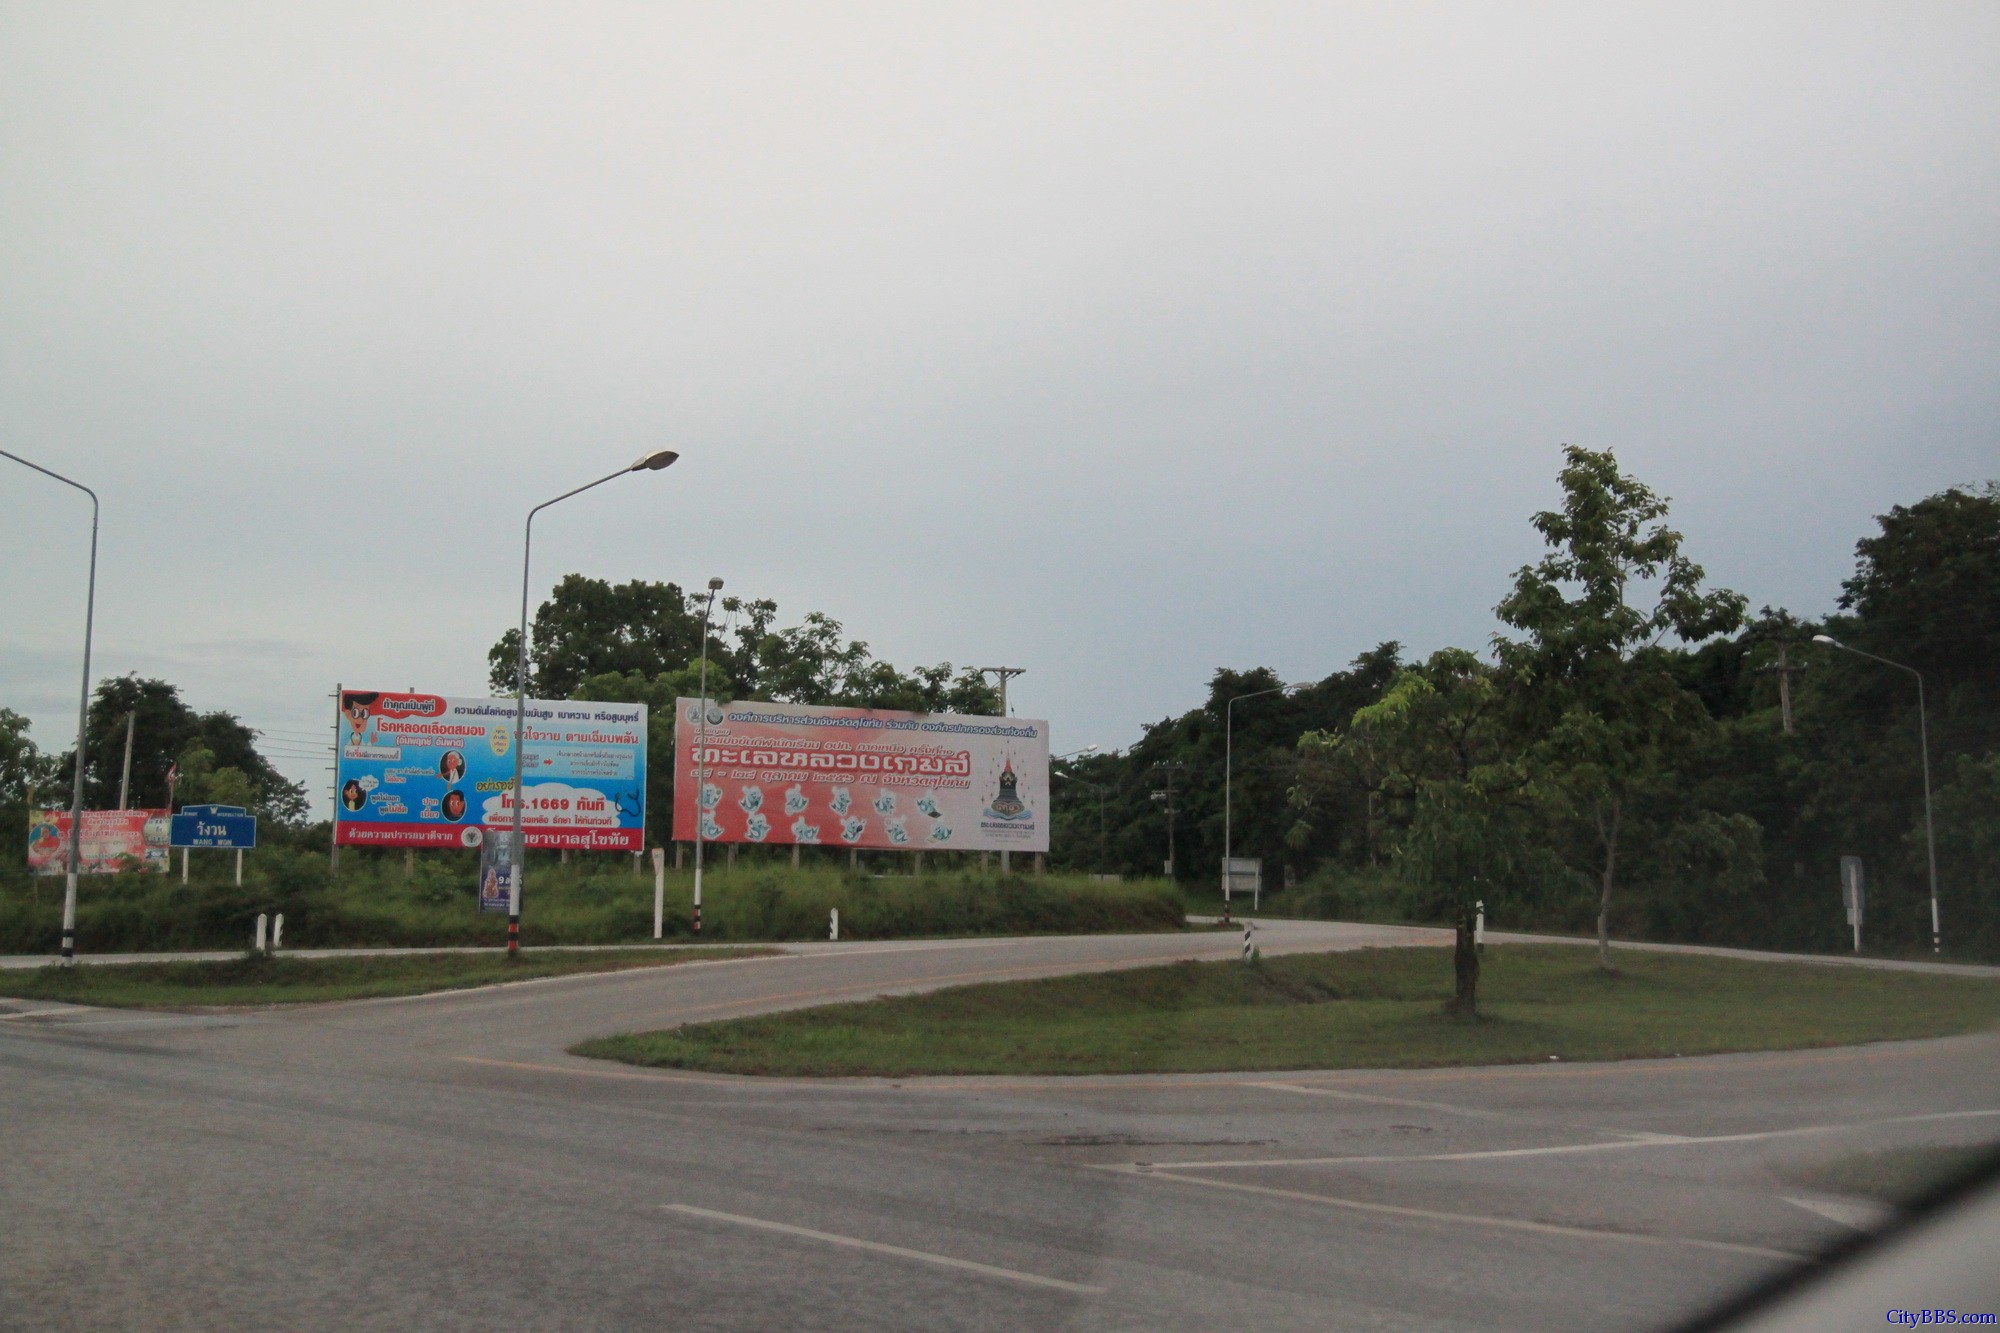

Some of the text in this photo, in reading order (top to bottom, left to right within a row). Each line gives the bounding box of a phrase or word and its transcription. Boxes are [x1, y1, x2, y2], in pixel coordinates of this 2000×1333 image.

[383, 698, 436, 714] ถ้าคุณเป็นผู้ที่
[454, 704, 518, 719] ความดันโลหิตสูง
[557, 711, 591, 721] เบาหวาน
[594, 709, 640, 724] หรือสูบบุหรี่
[376, 717, 486, 736] โรคหลอดเลือดสมอง
[886, 719, 919, 731] ร่วมกับ
[921, 722, 1038, 738] องค์กรปกครองส่วนท้องถิ่น
[566, 730, 640, 745] ตายเฉียบพลัน
[691, 747, 970, 775] ทะเลหลวงเกมส์
[476, 778, 516, 792] อย่ารอช้
[761, 770, 809, 782] ตุลาคม
[882, 773, 971, 790] จังหวัดสุโขทัย
[576, 796, 605, 812] ทันที
[197, 820, 228, 836] วังวน
[552, 814, 572, 824] รักษา
[574, 814, 613, 826] ให้ทันท่วงที
[193, 838, 213, 846] WANG
[349, 827, 453, 842] ด้วยความปรารถนาดีจาก
